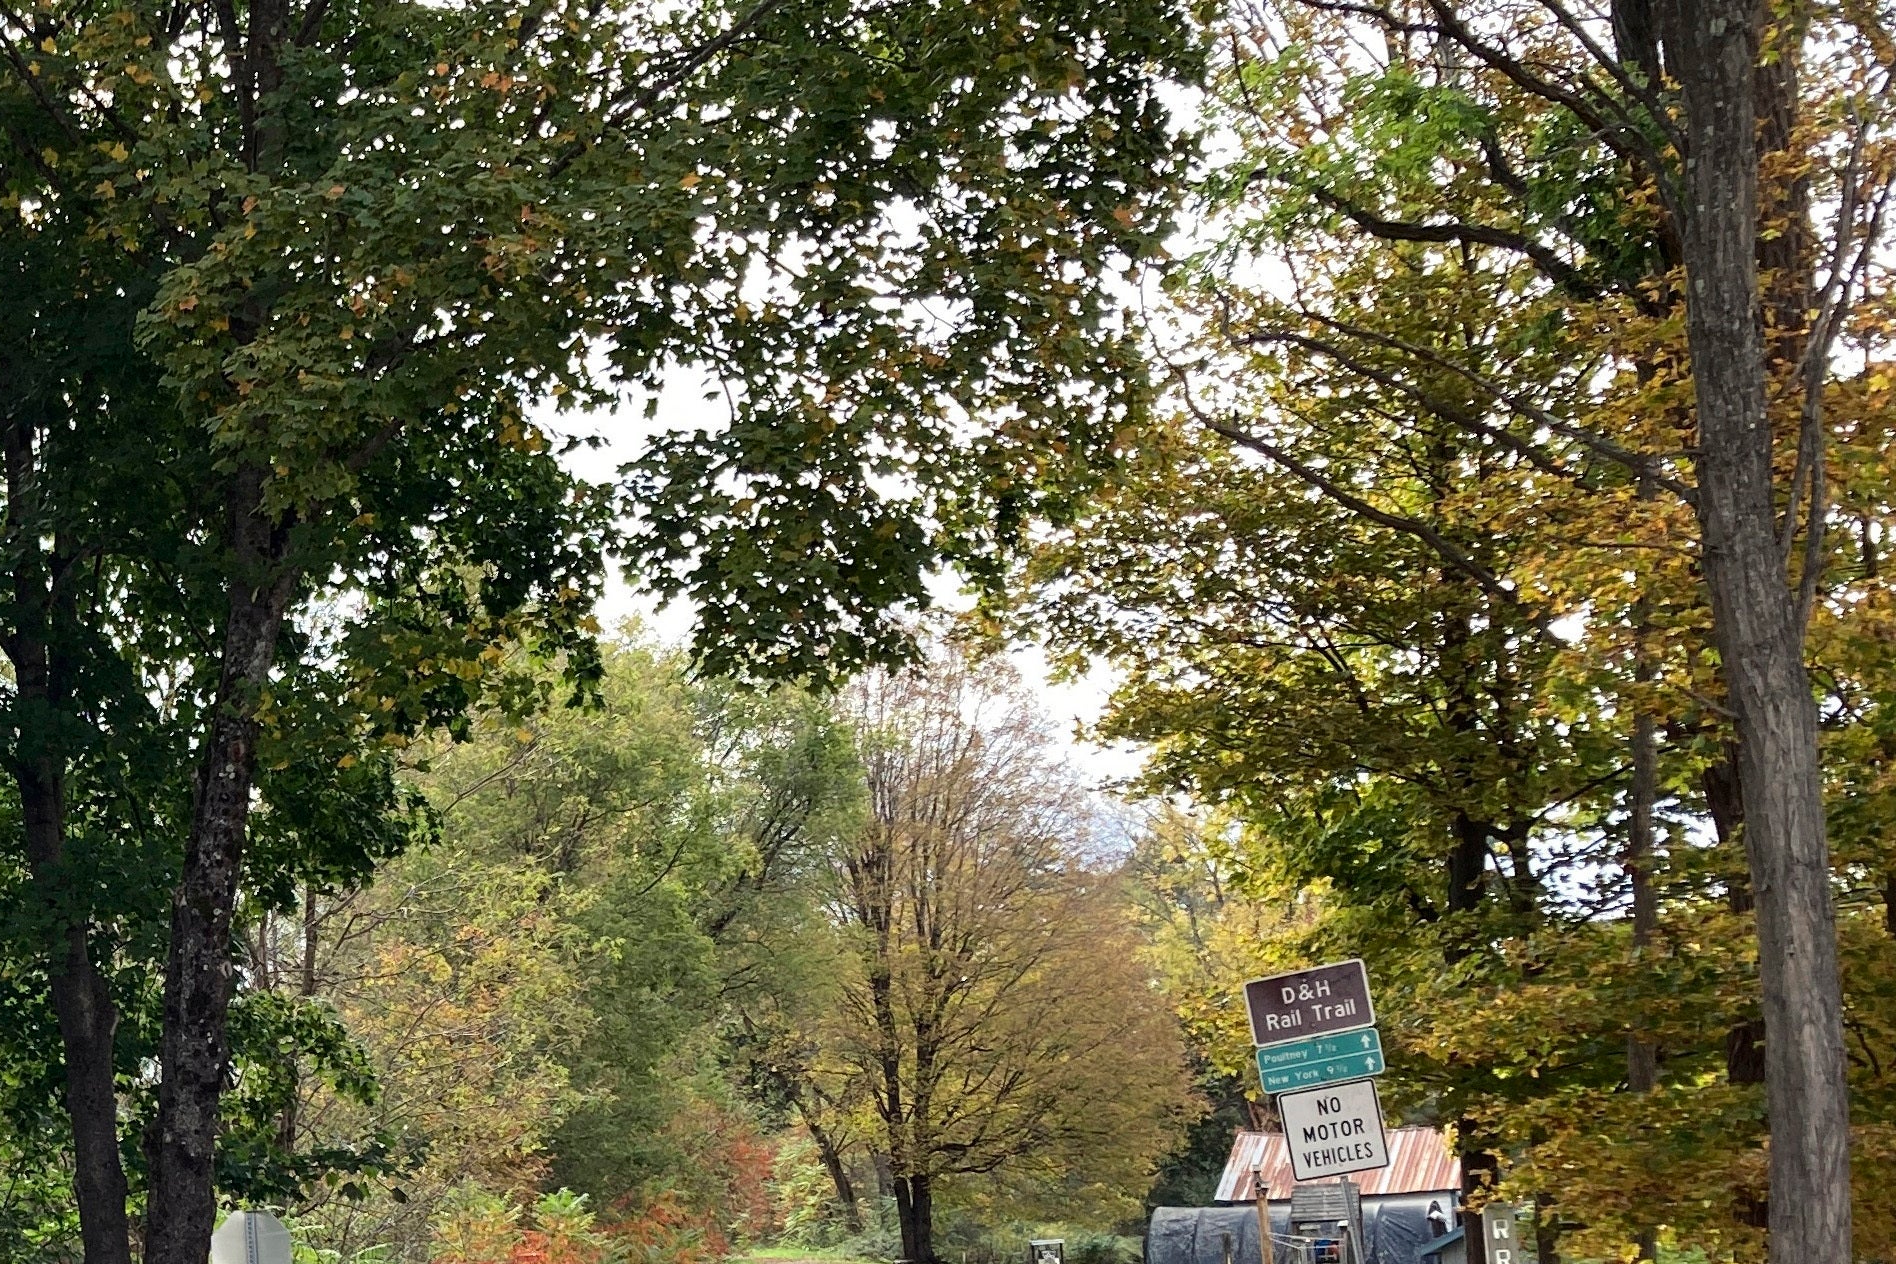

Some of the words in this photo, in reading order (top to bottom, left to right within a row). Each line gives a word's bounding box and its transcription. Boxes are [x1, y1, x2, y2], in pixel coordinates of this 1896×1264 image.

[1281, 980, 1331, 1005] D&H
[1265, 1009, 1302, 1031] Rail
[1311, 998, 1356, 1021] Trail
[1264, 1050, 1308, 1065] Poultney
[1268, 1074, 1289, 1086] New
[1294, 1069, 1319, 1081] York
[1316, 1097, 1341, 1116] NO
[1303, 1118, 1365, 1143] MOTOR
[1303, 1142, 1373, 1168] VEHICLES
